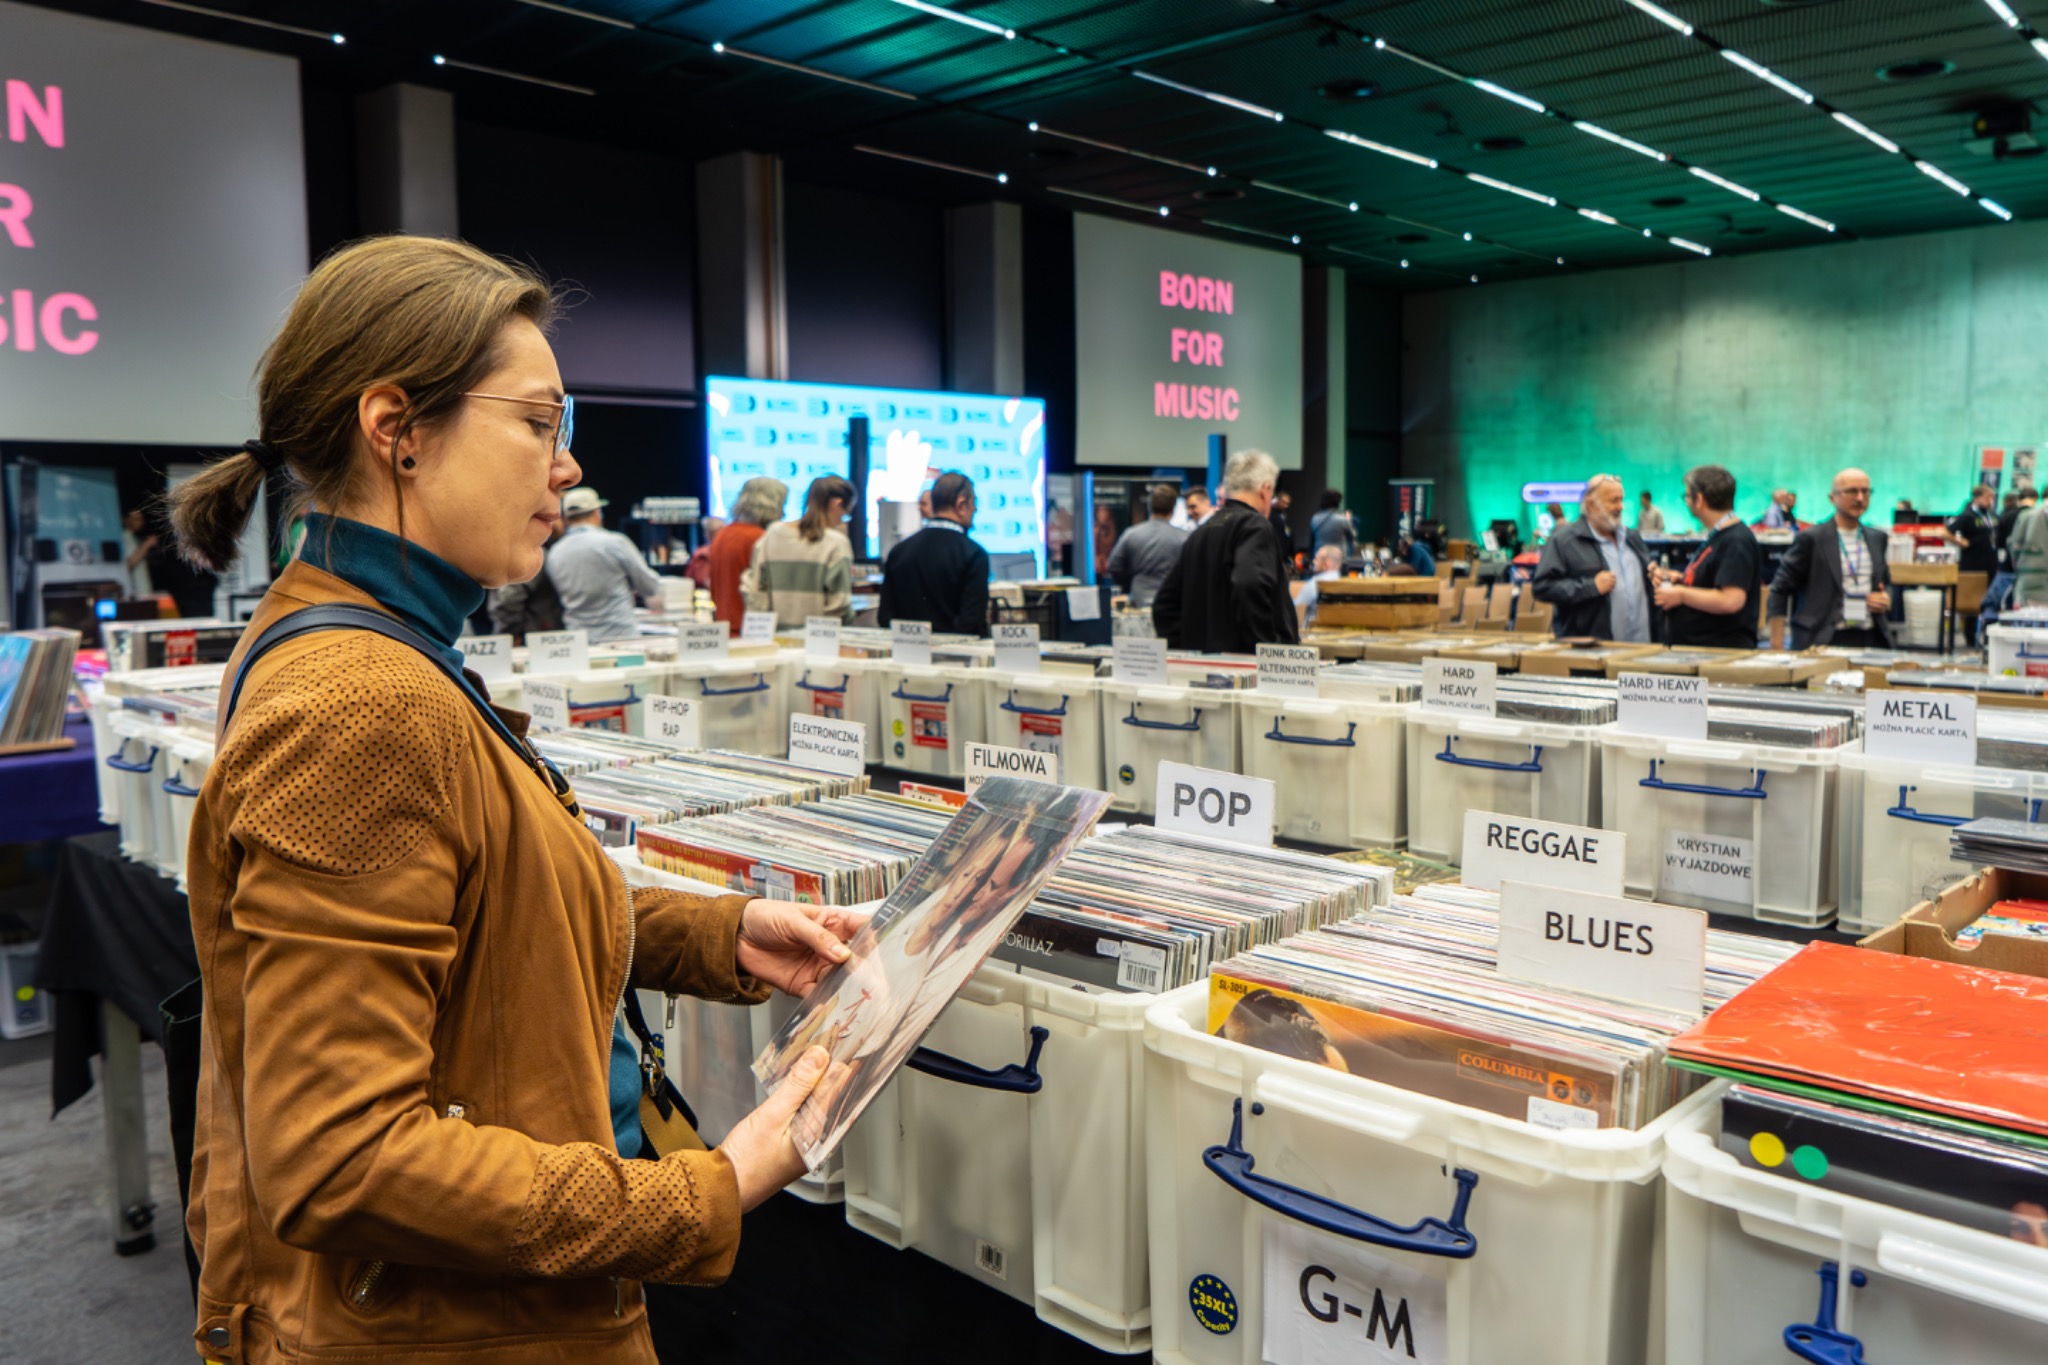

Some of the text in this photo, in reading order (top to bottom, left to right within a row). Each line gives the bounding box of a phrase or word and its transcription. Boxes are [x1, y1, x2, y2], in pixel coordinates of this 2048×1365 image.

[0, 78, 65, 148] N
[1159, 270, 1234, 315] BORN
[0, 289, 99, 356] IC
[1171, 327, 1224, 367] FOR
[1154, 381, 1240, 422] MUSIC
[900, 624, 921, 635] ROCK
[1001, 626, 1027, 638] ROCK
[463, 641, 498, 656] JAZZ
[687, 640, 719, 650] POLSKA
[1260, 647, 1315, 661] PUNK ROCK
[1259, 663, 1316, 676] ALTERNATIVE
[1443, 666, 1474, 679] HARD
[1440, 684, 1477, 697] HEAVY
[1619, 676, 1699, 691] HARD HEAVY
[1622, 692, 1648, 702] MOŻNA
[532, 703, 554, 720] DISCO
[653, 701, 690, 717] HIP-HOP
[1883, 699, 1957, 721] METAL
[662, 721, 680, 738] RAP
[793, 722, 859, 744] ELEKTRONICZNA
[1872, 722, 1902, 733] MOŻNA
[1938, 728, 1968, 739] KARTĄ
[973, 747, 1047, 775] FILMOWA
[1173, 782, 1252, 827] POP
[1487, 822, 1599, 865] REGGAE
[1677, 837, 1741, 858] KRYSTIAN
[1665, 855, 1752, 879] WYJAZDOWE
[1544, 911, 1654, 956] BLUES
[1218, 979, 1248, 994] SL-3058
[1460, 1053, 1545, 1084] COLUMBIA
[1199, 1292, 1228, 1316] 35XL
[1299, 1264, 1416, 1359] G-M
[1196, 1309, 1231, 1332] Capacity
